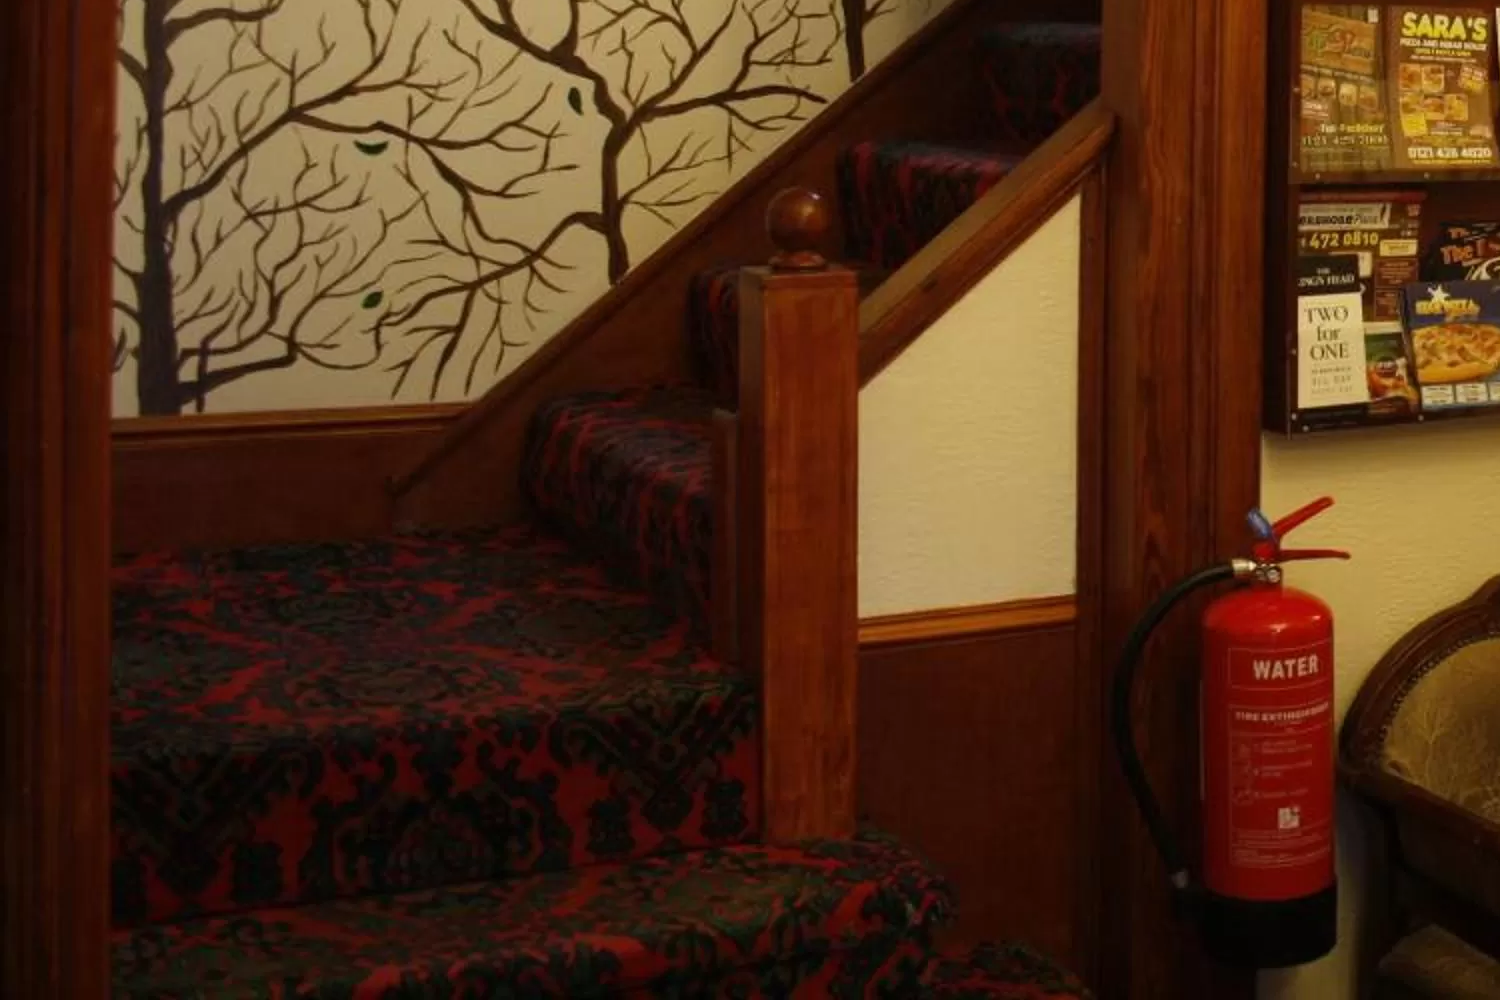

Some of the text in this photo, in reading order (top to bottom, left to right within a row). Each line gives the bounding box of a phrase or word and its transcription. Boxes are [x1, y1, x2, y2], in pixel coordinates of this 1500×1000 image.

[1401, 11, 1487, 41] SARA'S
[1304, 305, 1349, 324] TWO
[1317, 326, 1341, 342] for
[1310, 343, 1350, 361] ONE
[1253, 654, 1319, 681] WATER
[1235, 710, 1259, 722] FIRE
